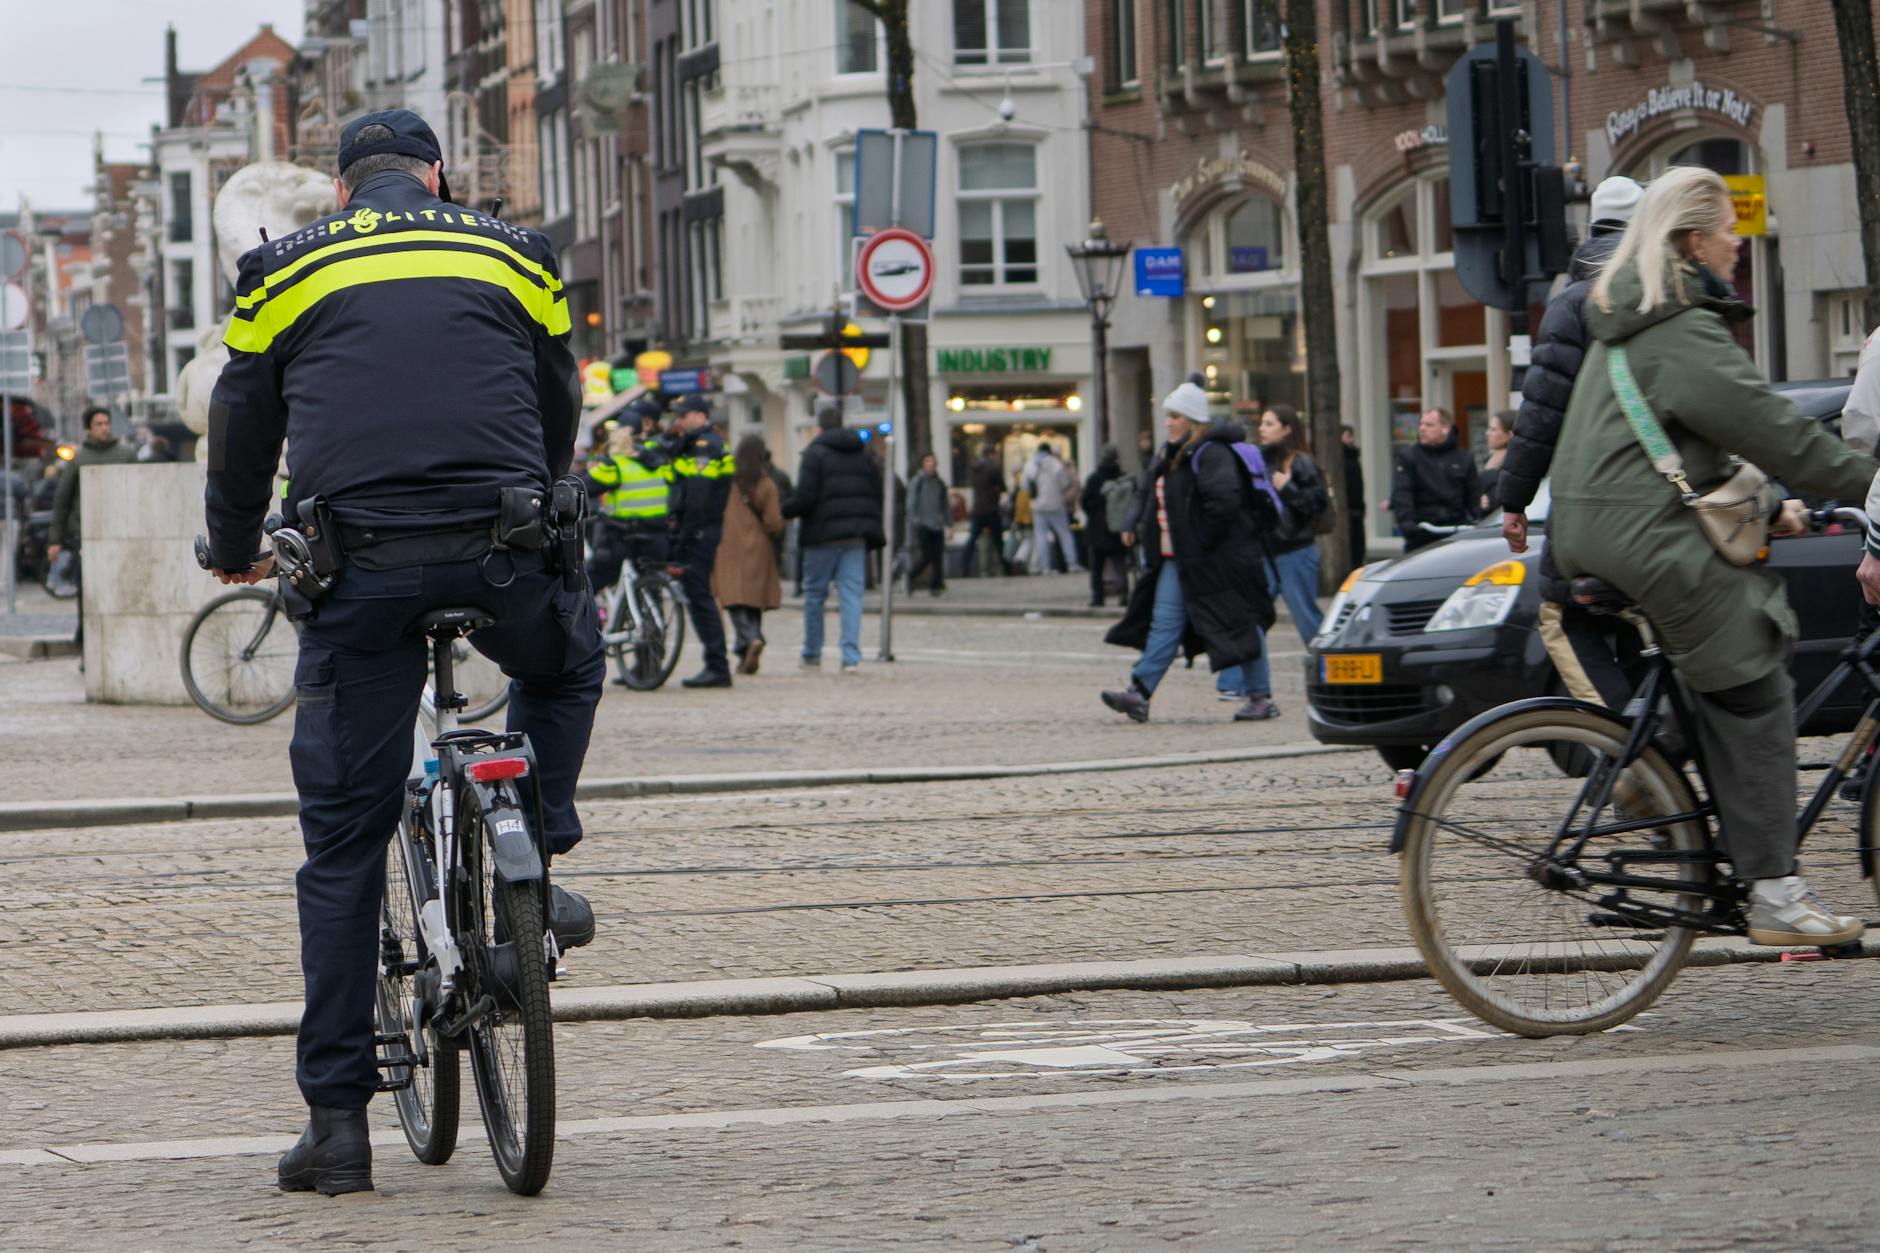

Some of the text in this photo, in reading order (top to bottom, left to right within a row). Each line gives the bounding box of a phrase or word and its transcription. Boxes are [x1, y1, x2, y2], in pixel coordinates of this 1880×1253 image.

[1648, 86, 1691, 116] Believe
[1694, 81, 1705, 107] It
[1706, 89, 1721, 109] or
[1721, 88, 1751, 127] Not!
[329, 207, 479, 235] POLITIE
[1145, 255, 1180, 268] DAM
[937, 347, 1051, 372] INDUSTRY
[500, 821, 520, 832] H4
